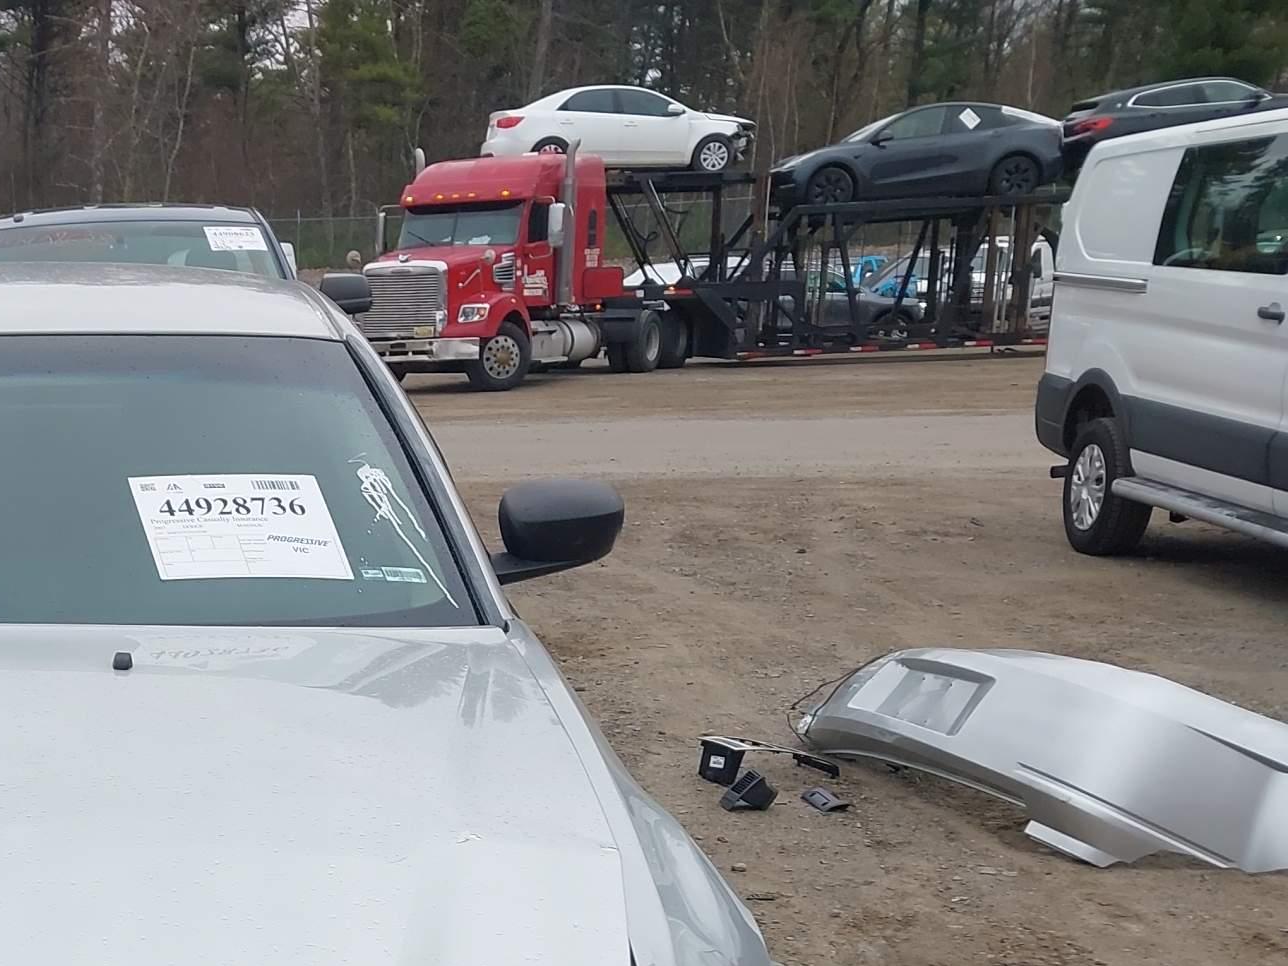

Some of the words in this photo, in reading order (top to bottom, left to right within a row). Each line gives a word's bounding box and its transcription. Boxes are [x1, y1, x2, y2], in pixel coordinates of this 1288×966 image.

[159, 496, 307, 517] 44928736
[150, 517, 196, 526] Progressive
[197, 515, 230, 524] Casualty
[232, 515, 269, 523] Insurance
[266, 534, 330, 547] PROGRESSIVE
[292, 545, 311, 554] VIC
